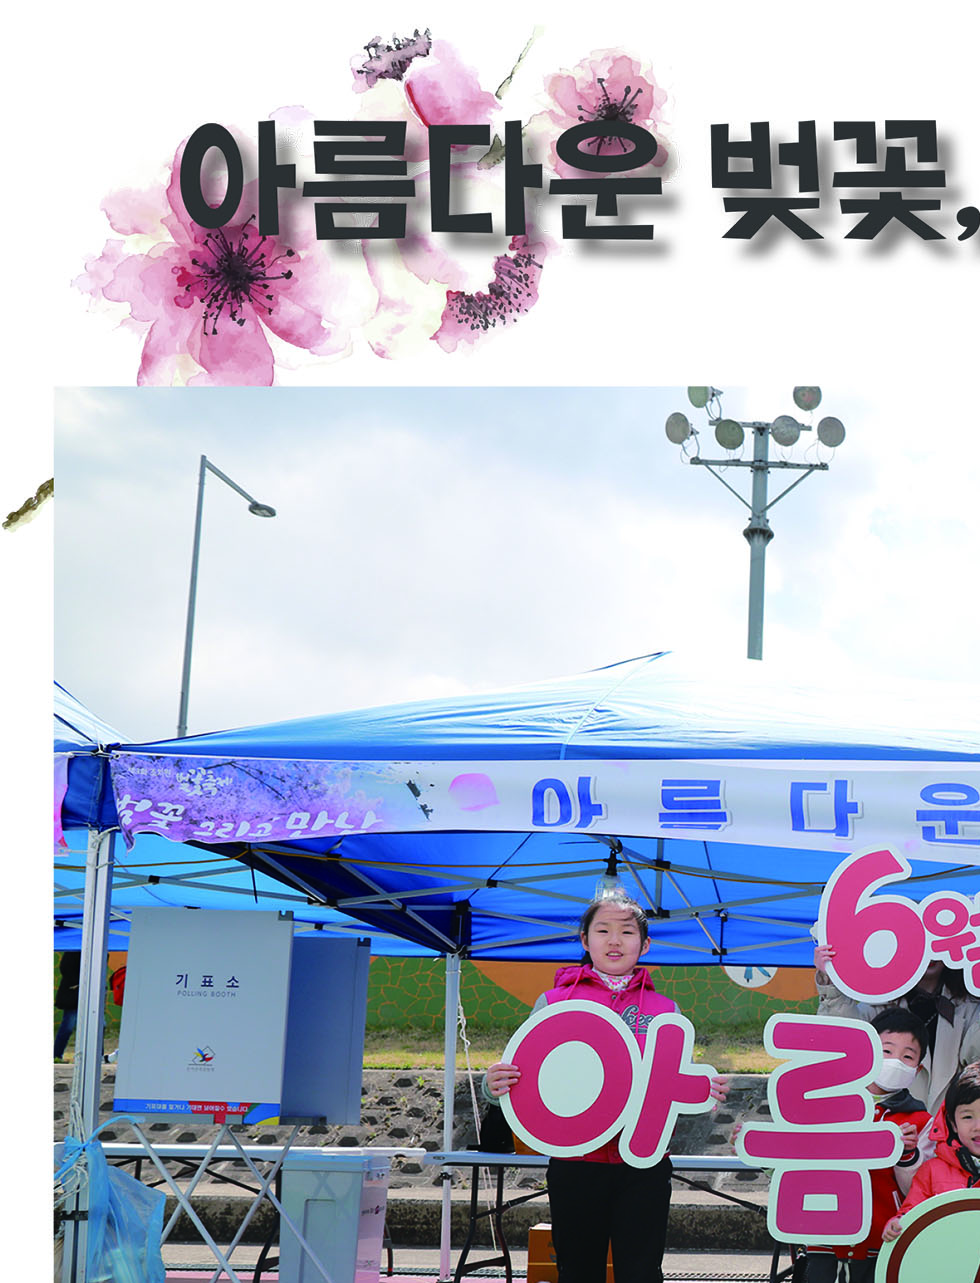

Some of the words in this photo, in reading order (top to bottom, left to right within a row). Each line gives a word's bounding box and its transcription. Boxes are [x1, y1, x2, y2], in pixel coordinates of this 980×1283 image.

[175, 973, 240, 989] 기표소
[177, 989, 208, 998] POLLING
[210, 990, 237, 998] BOOTH
